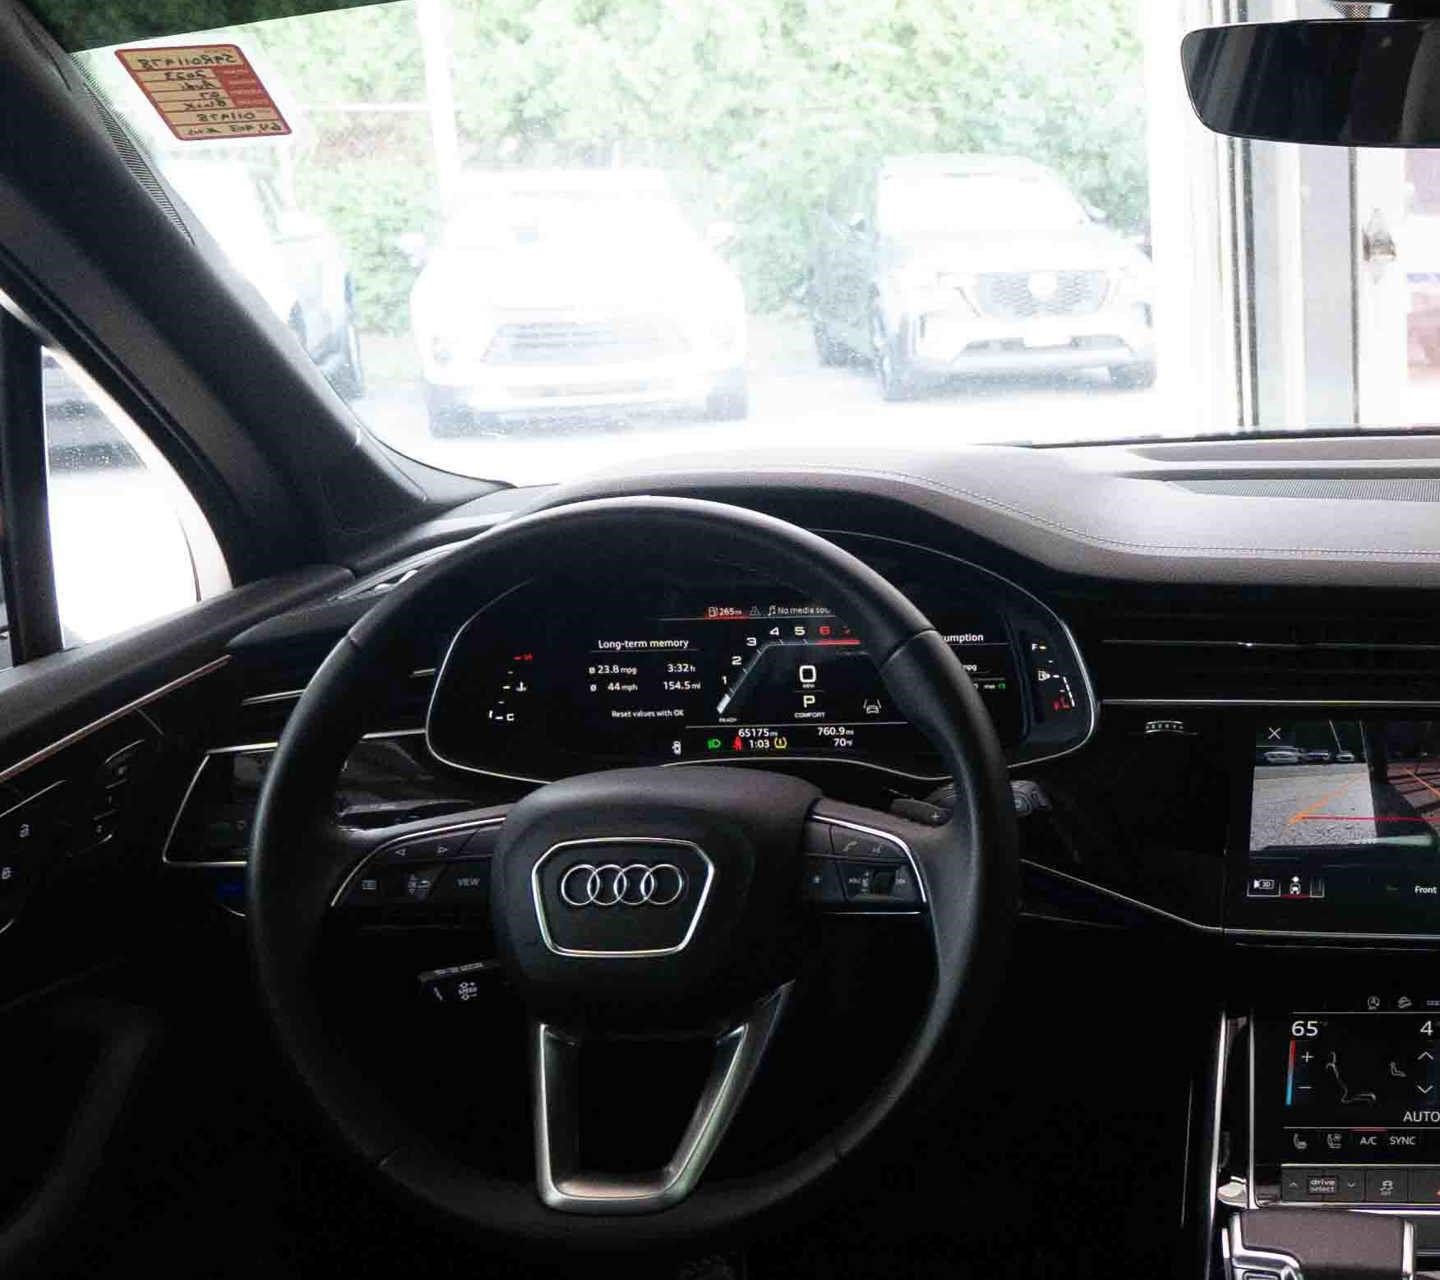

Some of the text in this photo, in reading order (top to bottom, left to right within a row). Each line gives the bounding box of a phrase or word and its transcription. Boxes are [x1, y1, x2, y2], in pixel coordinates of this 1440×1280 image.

[769, 627, 780, 636] 4
[794, 626, 806, 636] 5
[598, 639, 689, 650] Long-term memory
[746, 637, 757, 646] 3
[731, 656, 742, 665] 2
[597, 665, 619, 674] 23.8
[667, 663, 689, 672] 3:32
[799, 665, 817, 683] 0
[722, 676, 727, 684] 1
[608, 682, 621, 691] 44
[663, 681, 691, 690] 154.5
[803, 695, 815, 708] P
[611, 710, 632, 718] Reset
[673, 709, 685, 717] OK
[738, 728, 770, 738] 65175
[817, 727, 845, 736] 760.9
[749, 739, 770, 749] 1:03
[1414, 884, 1438, 895] Front
[1291, 1020, 1318, 1037] 65
[1420, 1020, 1433, 1036] 4
[1403, 1111, 1440, 1123] AUTO
[1360, 1136, 1377, 1146] A/C
[1390, 1135, 1416, 1146] SYNC
[1310, 1178, 1336, 1186] drive
